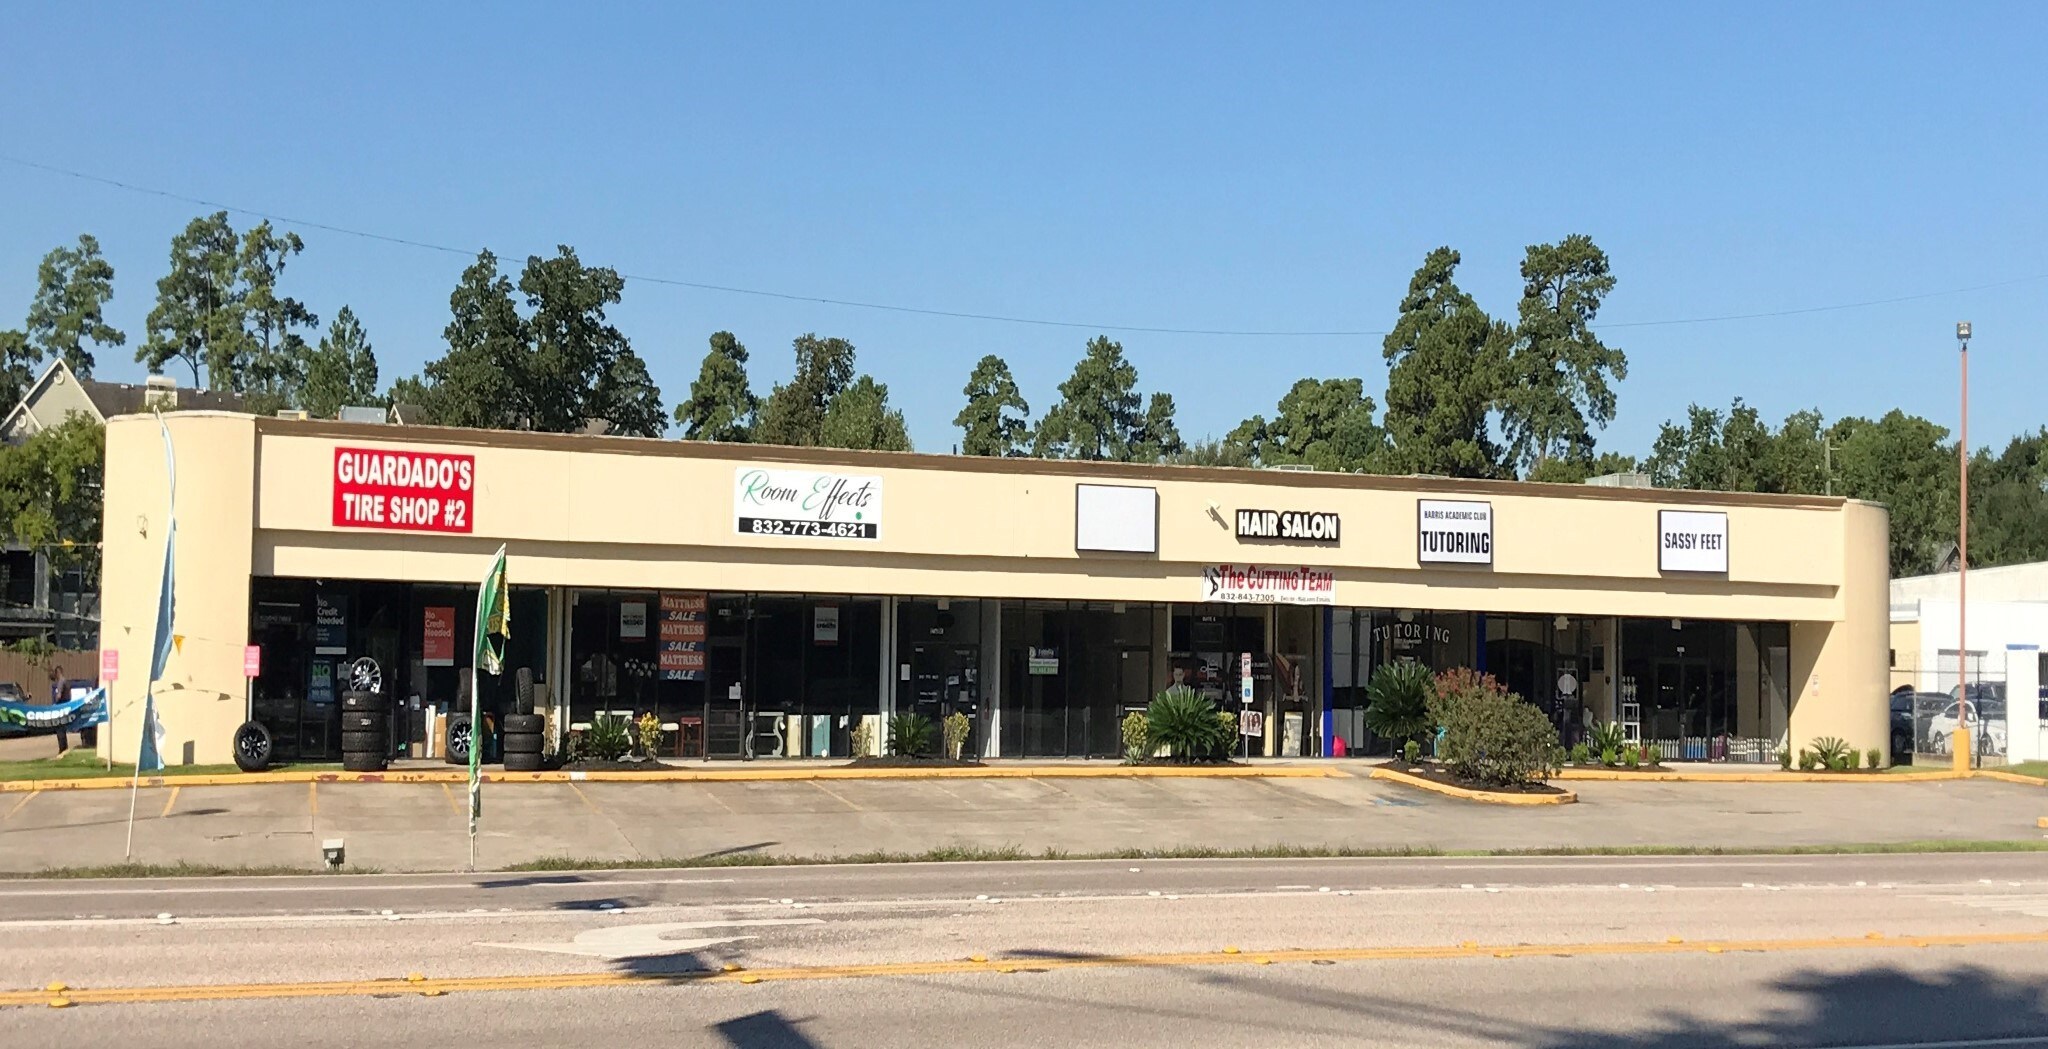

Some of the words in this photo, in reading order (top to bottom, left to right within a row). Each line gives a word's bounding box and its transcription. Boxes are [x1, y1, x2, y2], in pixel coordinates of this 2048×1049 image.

[338, 452, 472, 491] GUARDADO'S
[741, 470, 798, 506] Room
[802, 476, 875, 520] Effects
[343, 493, 385, 522] TIRE
[390, 496, 440, 525] SHOP
[444, 499, 466, 527] #2
[1424, 511, 1444, 519] HARRIS
[1445, 511, 1472, 520] ACADEMIC
[1474, 512, 1487, 520] CLUB
[752, 519, 866, 537] 832-773-4621
[1238, 511, 1278, 536] HAIR
[1282, 513, 1337, 539] SALON
[1421, 531, 1489, 554] TUTORING
[1665, 532, 1697, 549] SASSY
[1701, 534, 1722, 550] FEET
[1220, 565, 1244, 589] The
[1247, 565, 1299, 590] CUTTING
[1301, 567, 1333, 591] TEAM
[661, 598, 704, 609] MATTRESS
[317, 616, 344, 625] Needed
[669, 611, 696, 621] SALE
[425, 619, 445, 628] Credit
[425, 628, 452, 637] Needed
[661, 624, 704, 635] MATTRESS
[1373, 623, 1450, 643] TUTORING
[668, 641, 696, 652] SALE
[660, 654, 703, 665] MATTRESS
[312, 665, 331, 676] NO
[667, 670, 695, 680] SALE
[26, 706, 72, 720] CREDIT
